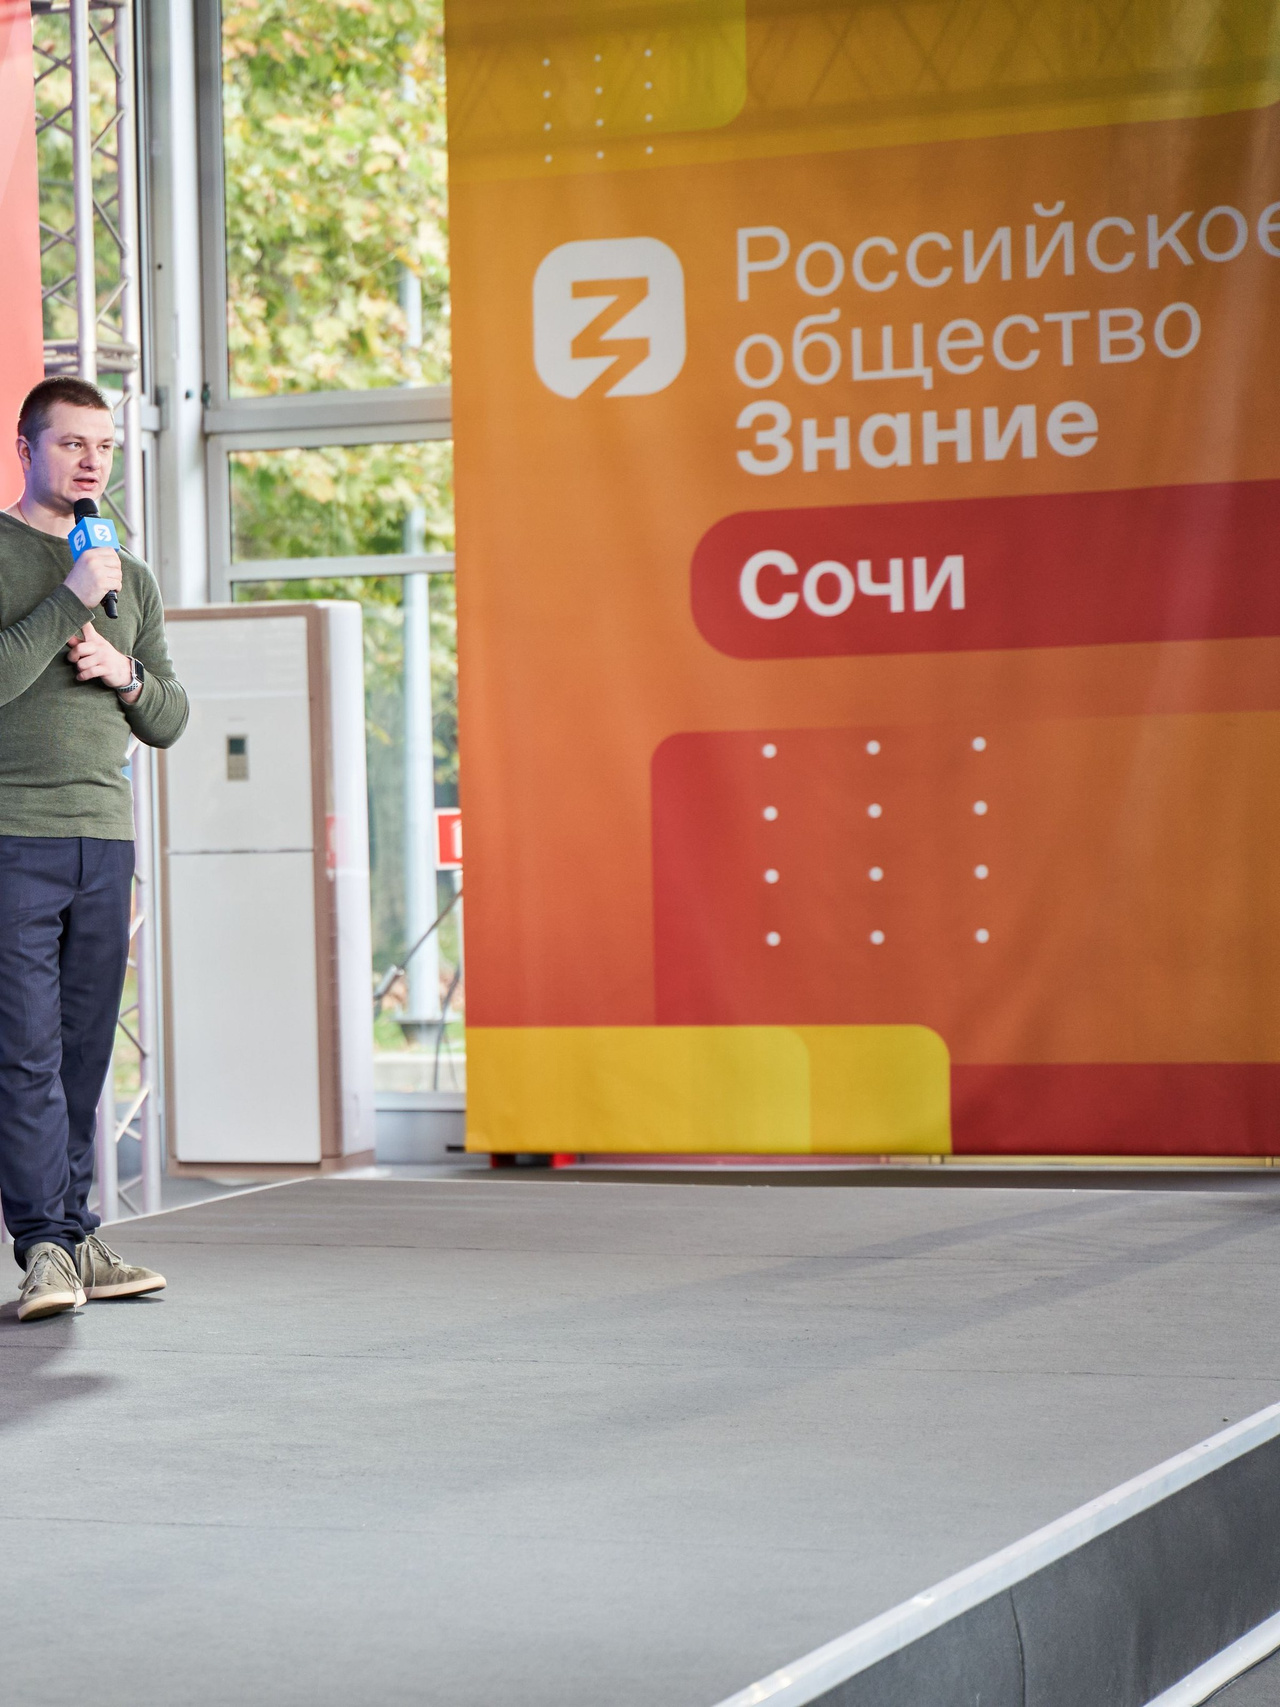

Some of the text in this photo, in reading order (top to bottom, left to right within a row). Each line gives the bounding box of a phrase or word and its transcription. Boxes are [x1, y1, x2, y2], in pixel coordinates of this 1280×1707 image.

[733, 301, 1203, 391] общество
[734, 399, 1100, 477] Знание
[738, 548, 967, 620] Сочи
